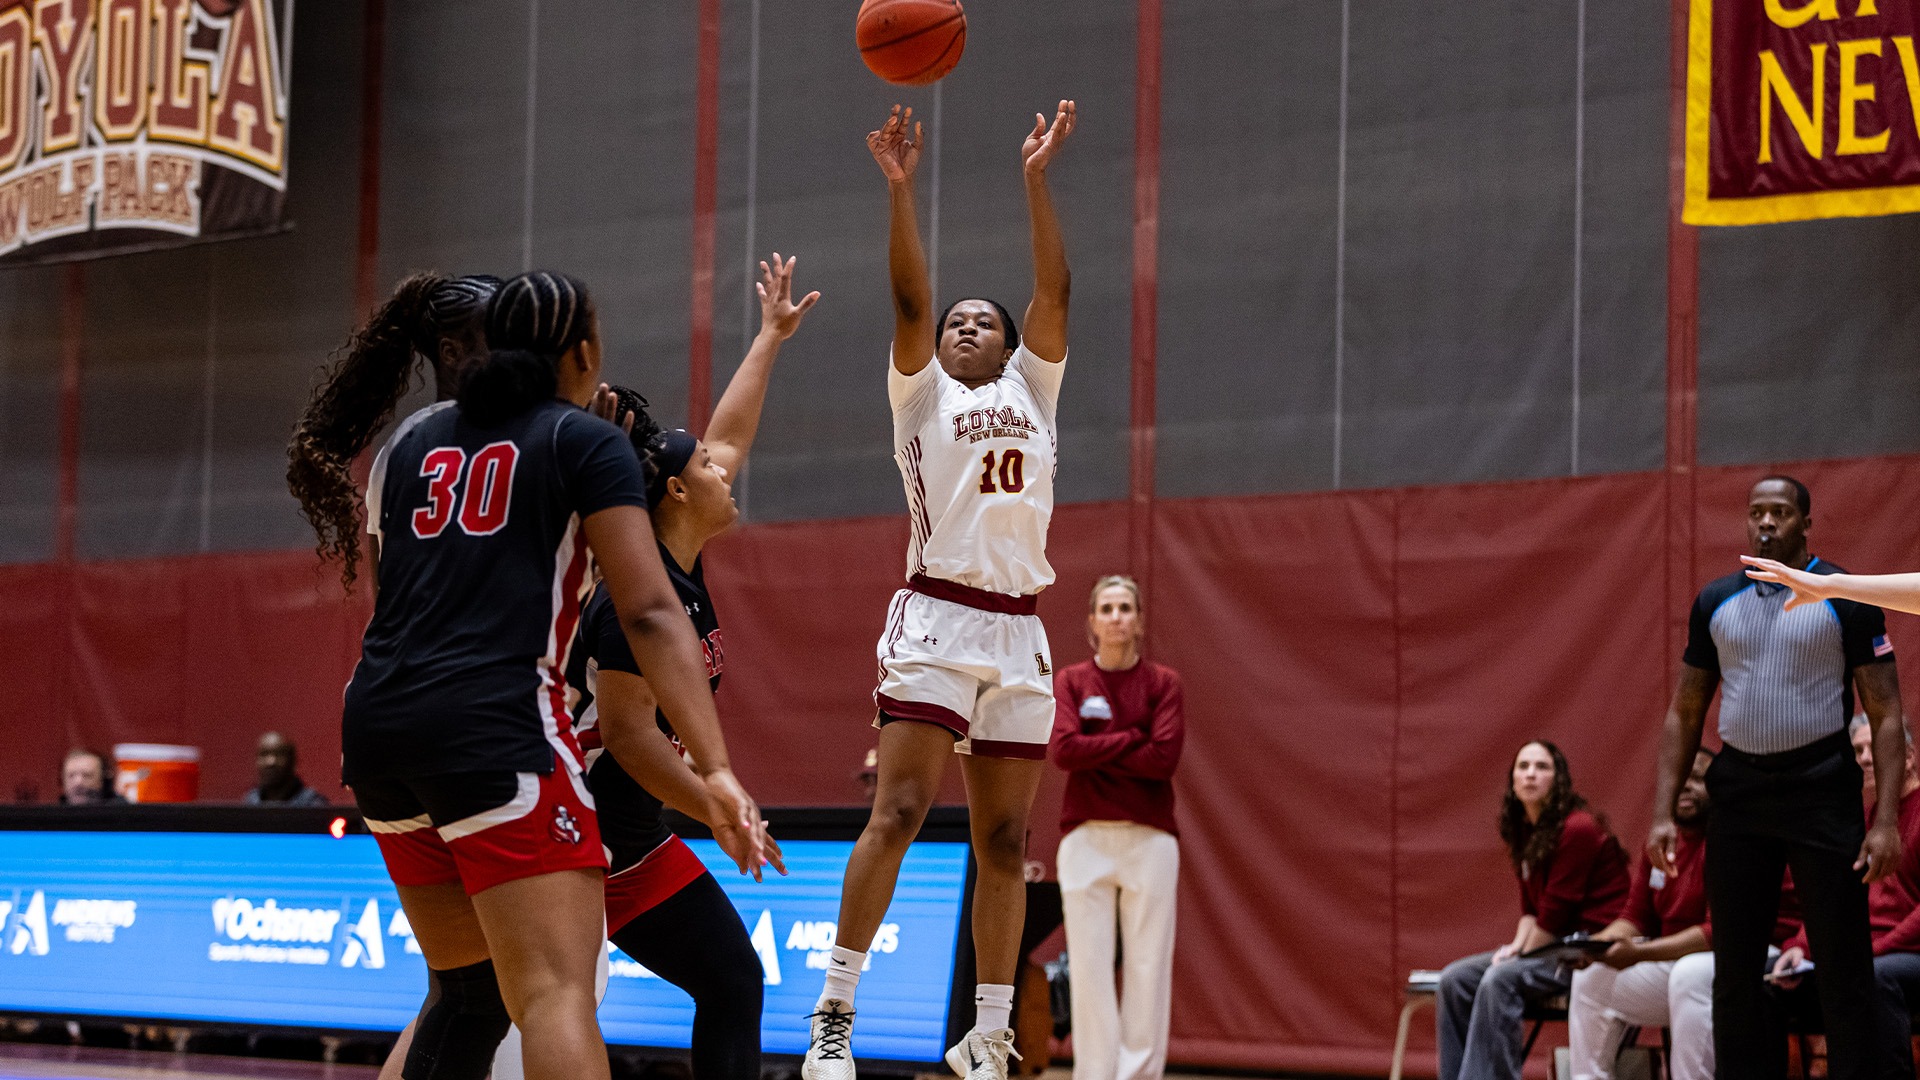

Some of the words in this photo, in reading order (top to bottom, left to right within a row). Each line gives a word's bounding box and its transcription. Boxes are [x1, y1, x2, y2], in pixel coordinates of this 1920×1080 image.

[99, 151, 197, 229] PACK
[953, 405, 1039, 441] LOYOLA
[969, 428, 991, 445] NEW
[992, 426, 1029, 440] ORLEANS
[411, 440, 520, 539] 30
[979, 448, 1025, 495] 10
[226, 898, 341, 943] Ochsner
